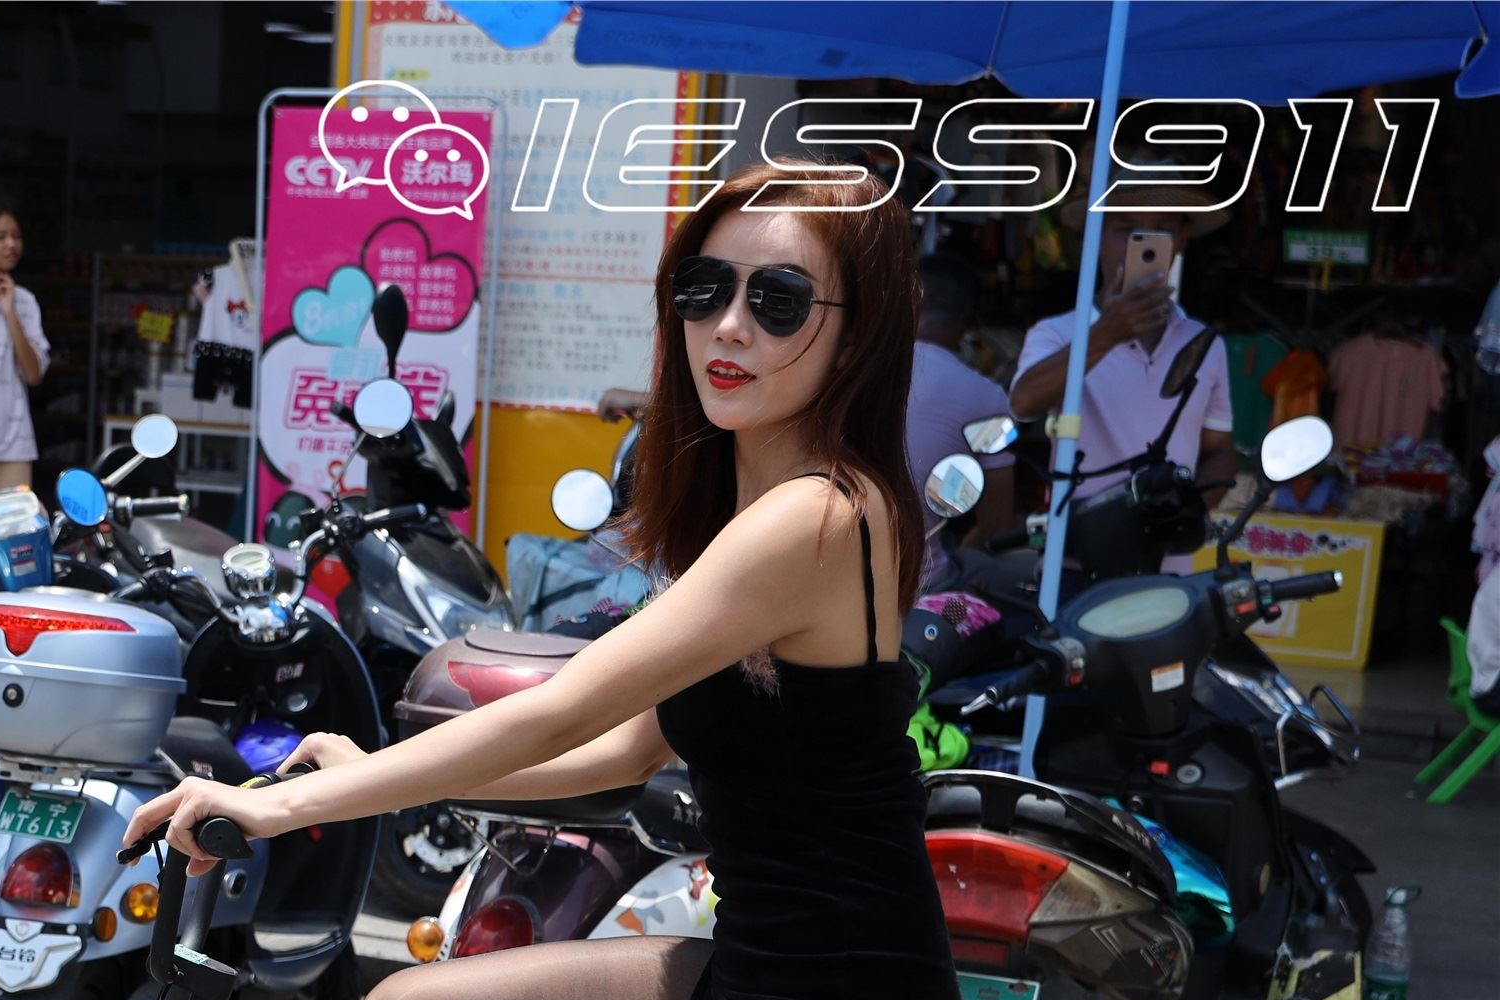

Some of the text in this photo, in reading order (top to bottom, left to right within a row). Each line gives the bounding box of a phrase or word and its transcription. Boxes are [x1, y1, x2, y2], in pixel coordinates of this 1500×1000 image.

[284, 156, 372, 187] CCTV
[401, 160, 474, 187] 沃尔玛
[0, 811, 72, 838] WT613
